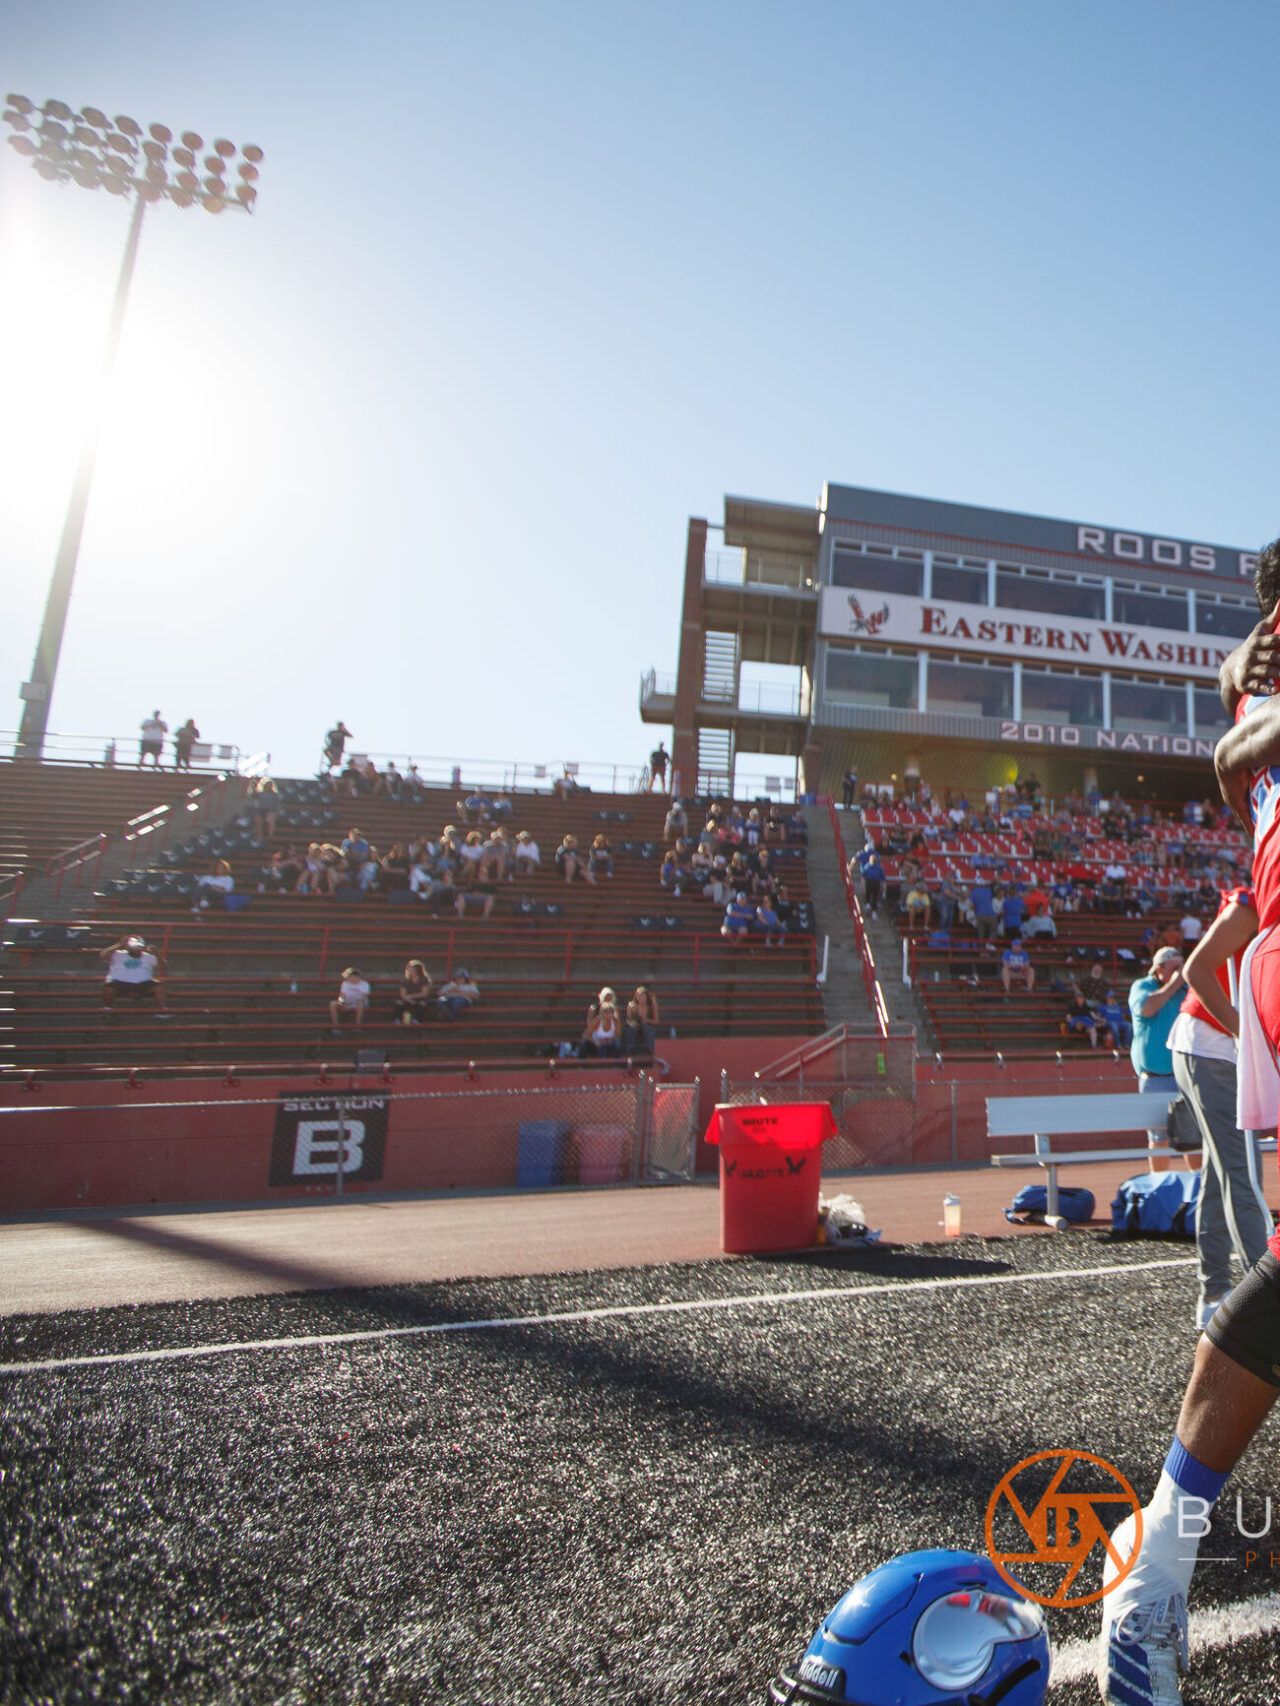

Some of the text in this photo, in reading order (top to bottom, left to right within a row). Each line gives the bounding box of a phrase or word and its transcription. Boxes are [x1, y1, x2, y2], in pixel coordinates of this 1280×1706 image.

[1077, 525, 1217, 571] ROOS
[920, 605, 1092, 652] EASTERN
[1001, 721, 1215, 756] 2010 NATION
[291, 1119, 367, 1176] B
